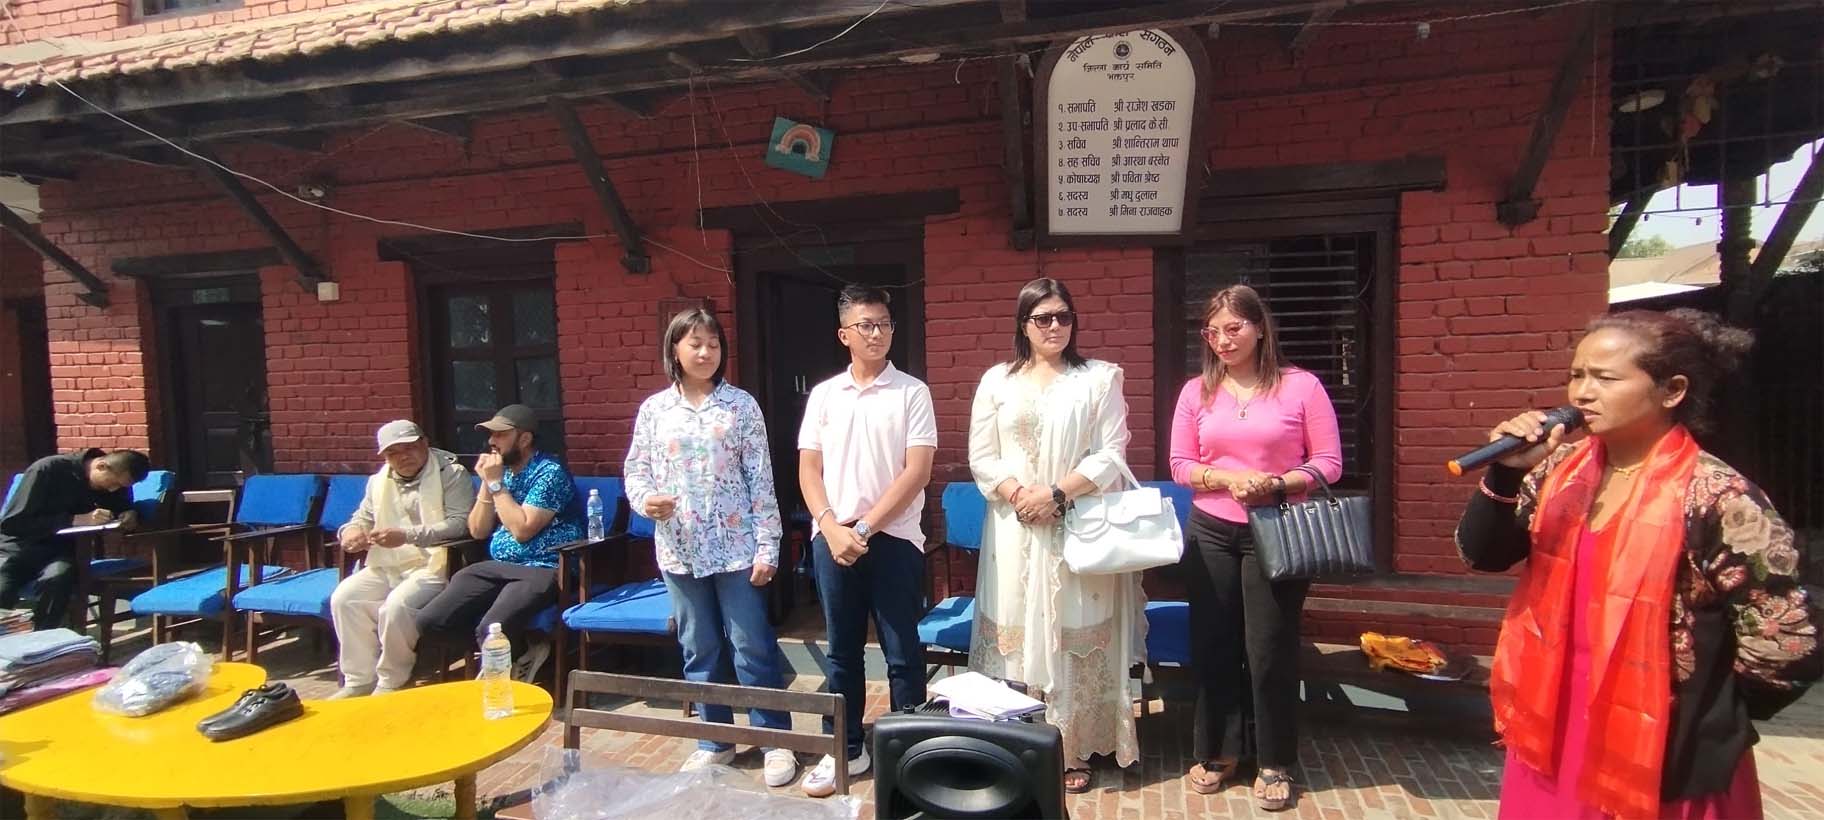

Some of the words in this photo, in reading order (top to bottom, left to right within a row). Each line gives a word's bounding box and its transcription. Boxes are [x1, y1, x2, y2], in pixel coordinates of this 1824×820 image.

[1136, 60, 1163, 70] समिति
[1067, 99, 1096, 114] सभापति
[1114, 99, 1124, 112] श्री
[1126, 98, 1148, 112] राजेश
[1113, 117, 1122, 131] श्री
[1067, 137, 1087, 150] सचिव
[1112, 136, 1122, 149] श्री
[1067, 157, 1078, 168] सह
[1081, 154, 1100, 167] सचिव
[1111, 154, 1121, 167] श्री
[1111, 171, 1120, 184] श्री
[1066, 191, 1088, 201] सदस्य
[1110, 188, 1119, 200] श्री
[1121, 191, 1133, 202] मधु
[1135, 191, 1158, 202] दुलाल
[1066, 208, 1088, 217] सदस्य
[1109, 205, 1118, 217] श्री
